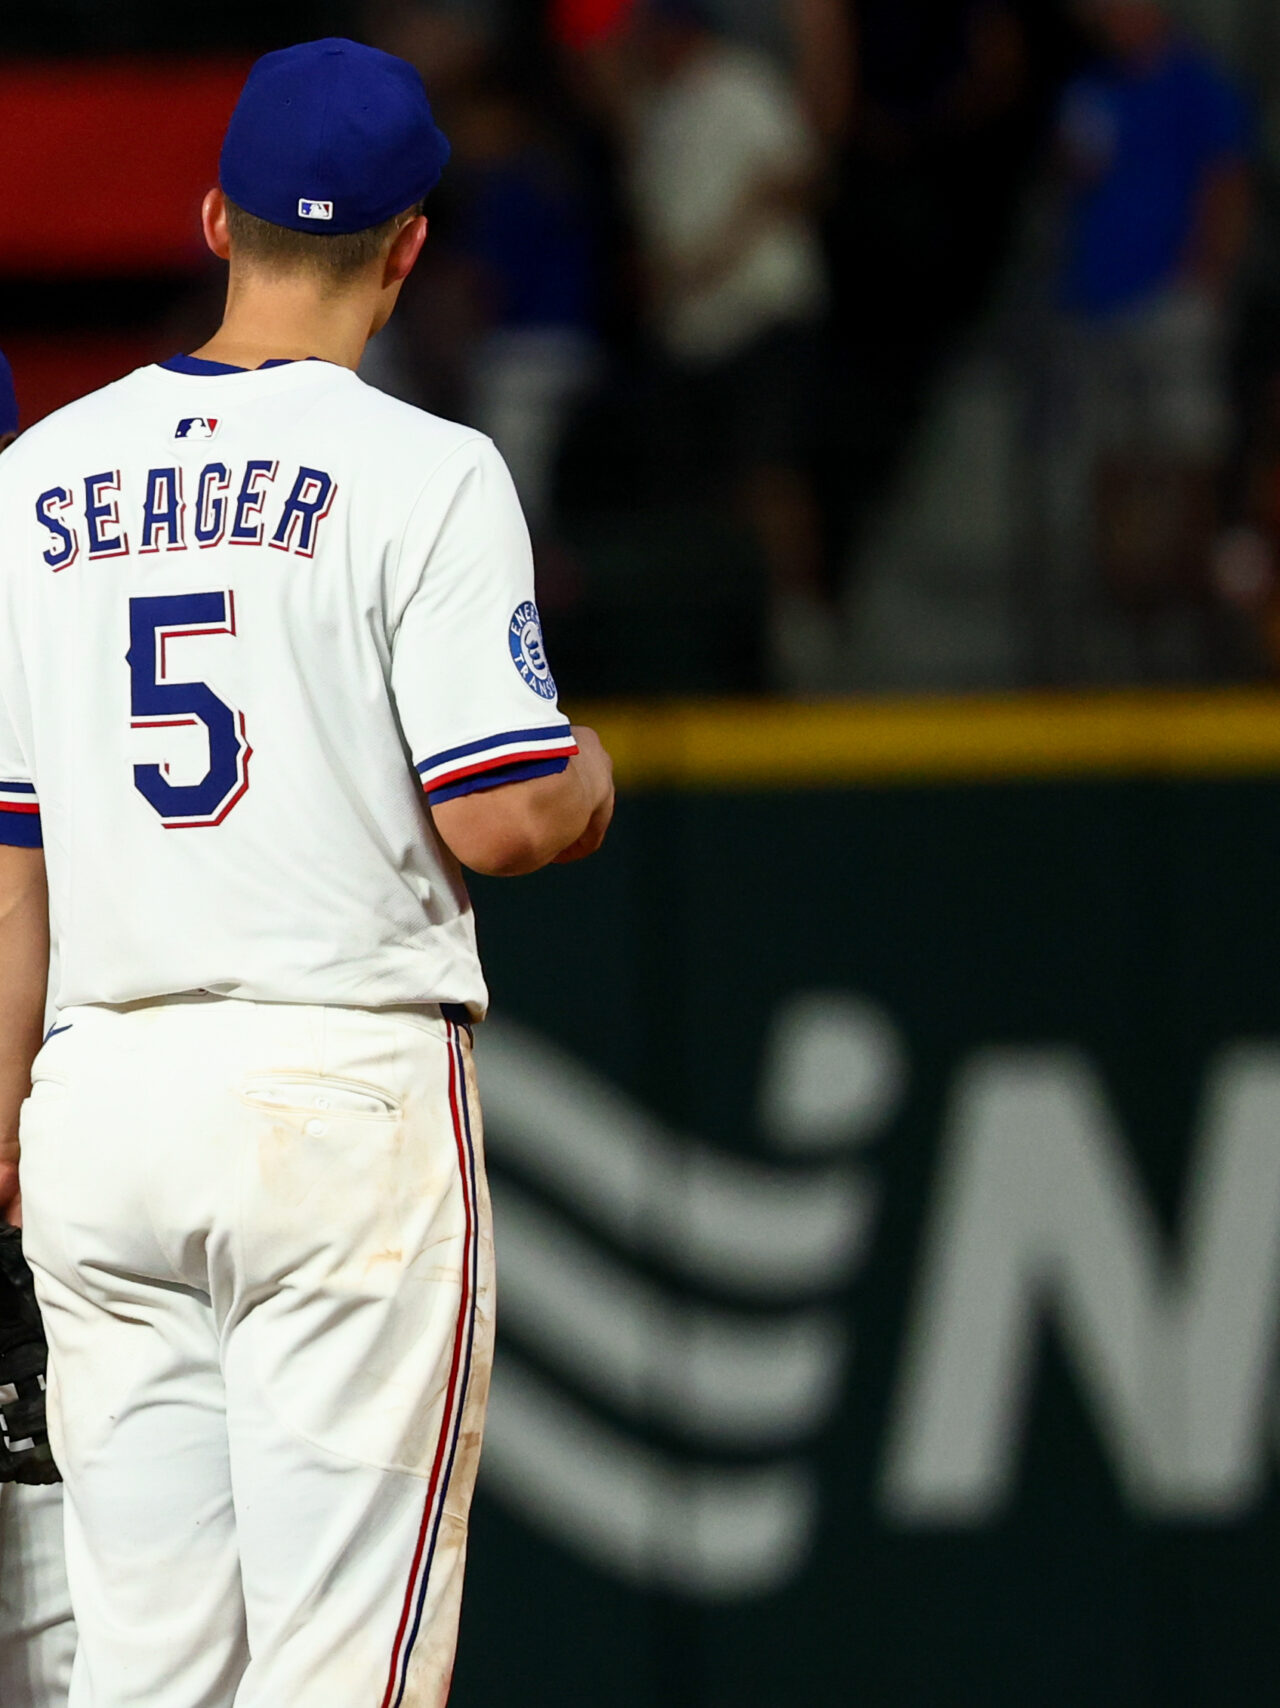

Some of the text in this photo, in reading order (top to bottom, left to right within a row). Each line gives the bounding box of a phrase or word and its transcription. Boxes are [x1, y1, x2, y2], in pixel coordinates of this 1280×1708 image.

[35, 460, 338, 573] SEAGER
[510, 603, 540, 637] ENER
[124, 588, 253, 830] 5
[514, 652, 556, 698] TRANS
